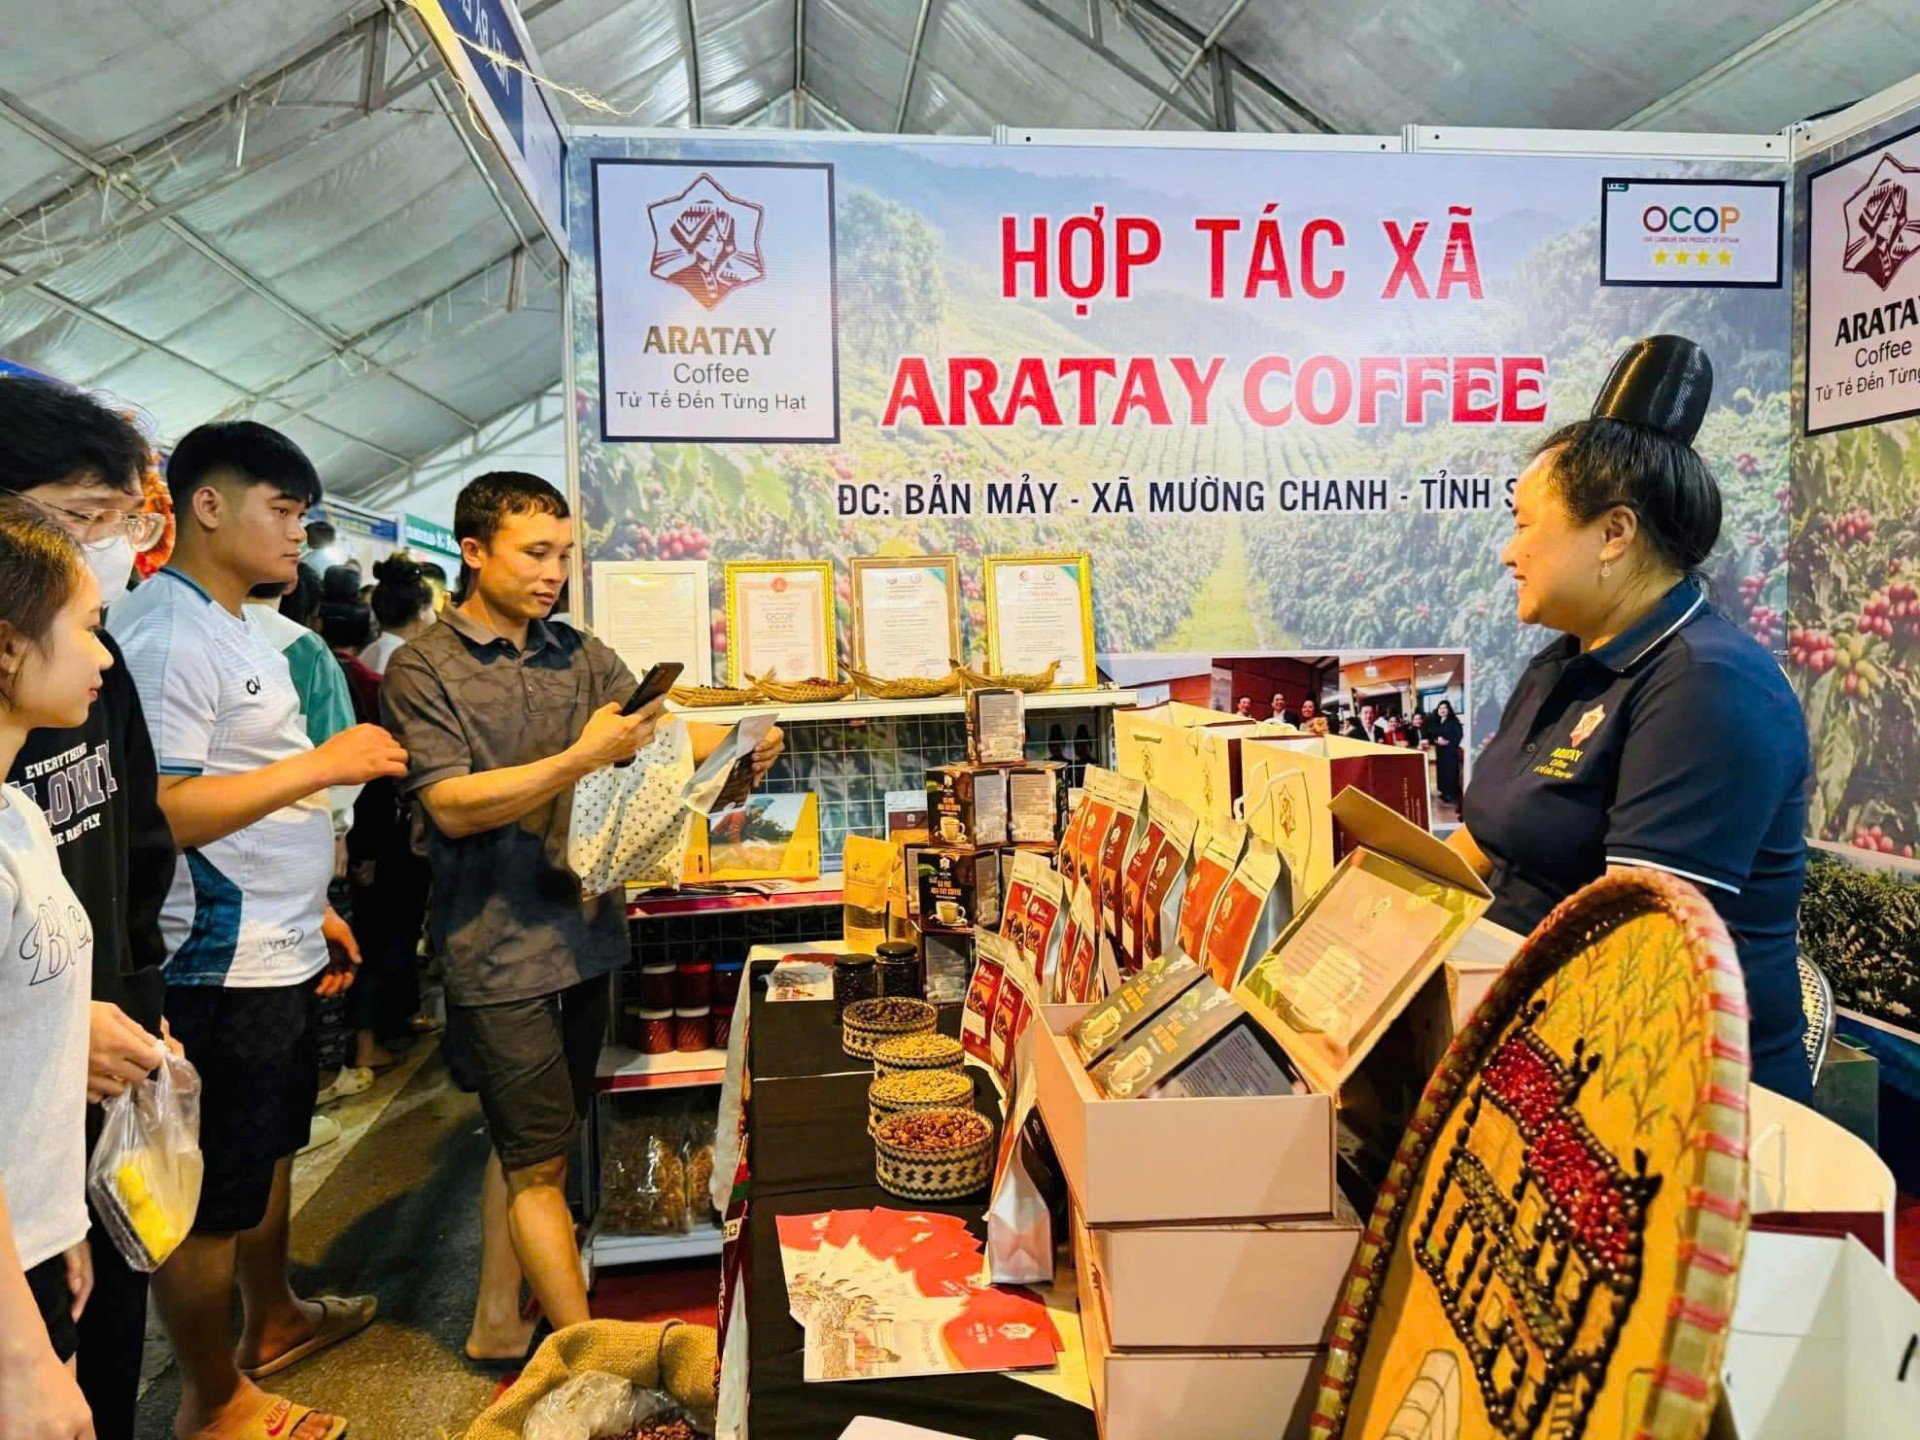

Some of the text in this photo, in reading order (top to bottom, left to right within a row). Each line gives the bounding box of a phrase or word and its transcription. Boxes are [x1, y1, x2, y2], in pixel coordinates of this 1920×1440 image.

[1643, 206, 1740, 233] OCOP
[1002, 203, 1484, 316] HỢP TÁC XÃ
[1835, 296, 1920, 347] ARATA
[642, 326, 776, 356] ARATAY
[1855, 340, 1912, 368] Coffee
[674, 363, 749, 384] Coffee
[1837, 377, 1853, 397] Tế
[1857, 370, 1884, 393] Đến
[648, 389, 671, 409] Tế
[677, 389, 714, 410] Đến
[775, 394, 807, 413] Hạt
[882, 355, 1548, 427] ARATAY COFFEE
[838, 485, 891, 515] ĐC:
[906, 475, 972, 515] BẢN
[987, 474, 1058, 514] MẢY
[1092, 478, 1134, 513] XÃ
[1150, 474, 1265, 512] MƯỜNG
[1280, 479, 1388, 511] CHANH
[1420, 470, 1490, 510] TỈNH
